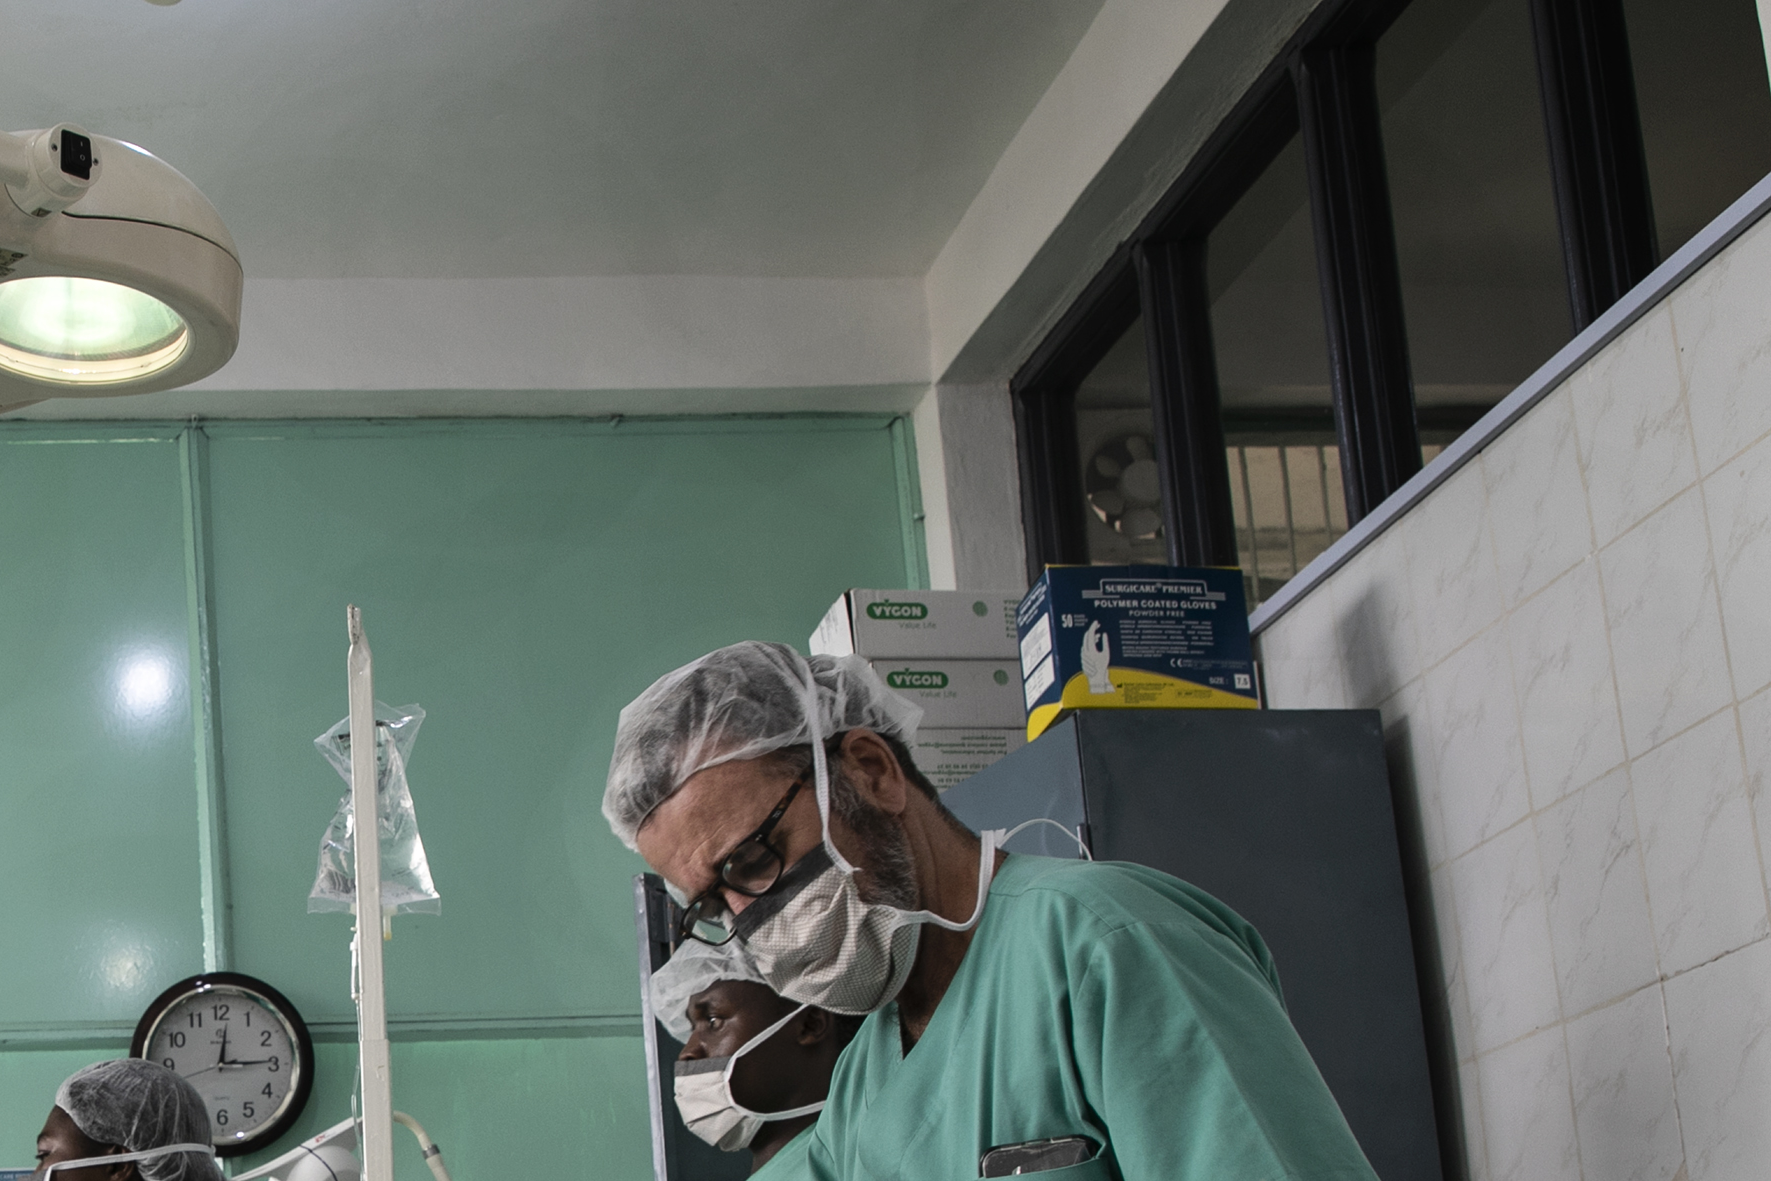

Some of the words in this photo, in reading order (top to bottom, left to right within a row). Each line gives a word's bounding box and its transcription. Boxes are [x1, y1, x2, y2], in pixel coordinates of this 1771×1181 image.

[1162, 584, 1203, 595] PREMIER
[873, 606, 922, 617] VYGON
[1094, 599, 1139, 608] POLYMER
[1140, 599, 1179, 609] COATED
[1180, 600, 1217, 610] GLOVES
[1061, 613, 1074, 628] 50
[1129, 610, 1165, 618] POWDER
[1166, 610, 1185, 618] FREE
[899, 622, 921, 630] Value
[923, 621, 937, 629] Life
[893, 675, 943, 686] VYGON
[919, 690, 941, 699] Value
[943, 690, 957, 698] Life
[188, 1012, 202, 1028] 11
[212, 1004, 230, 1021] 12
[244, 1011, 251, 1027] 1
[169, 1032, 186, 1048] 10
[260, 1030, 272, 1047] 2
[163, 1058, 175, 1071] 9
[268, 1056, 280, 1072] 3
[261, 1082, 273, 1098] 4
[242, 1101, 255, 1118] 5
[216, 1109, 228, 1126] 6
